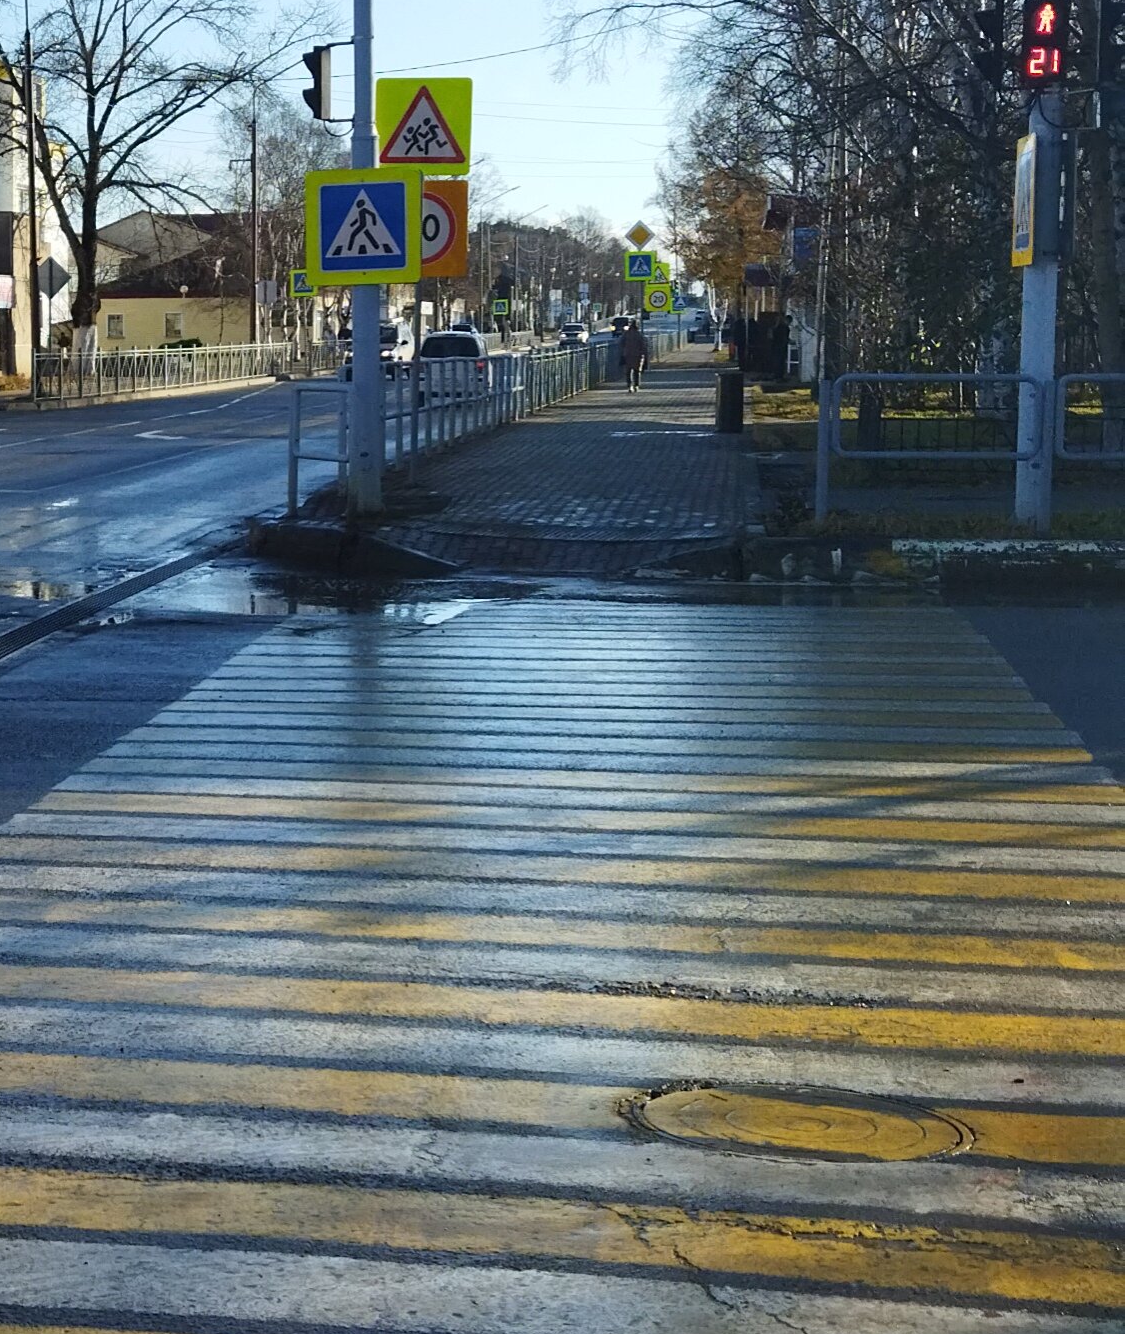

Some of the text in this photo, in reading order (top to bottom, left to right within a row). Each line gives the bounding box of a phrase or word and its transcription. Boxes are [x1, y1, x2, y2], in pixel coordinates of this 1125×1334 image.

[1027, 46, 1062, 77] 21
[422, 213, 441, 242] 0
[653, 295, 664, 303] 20
